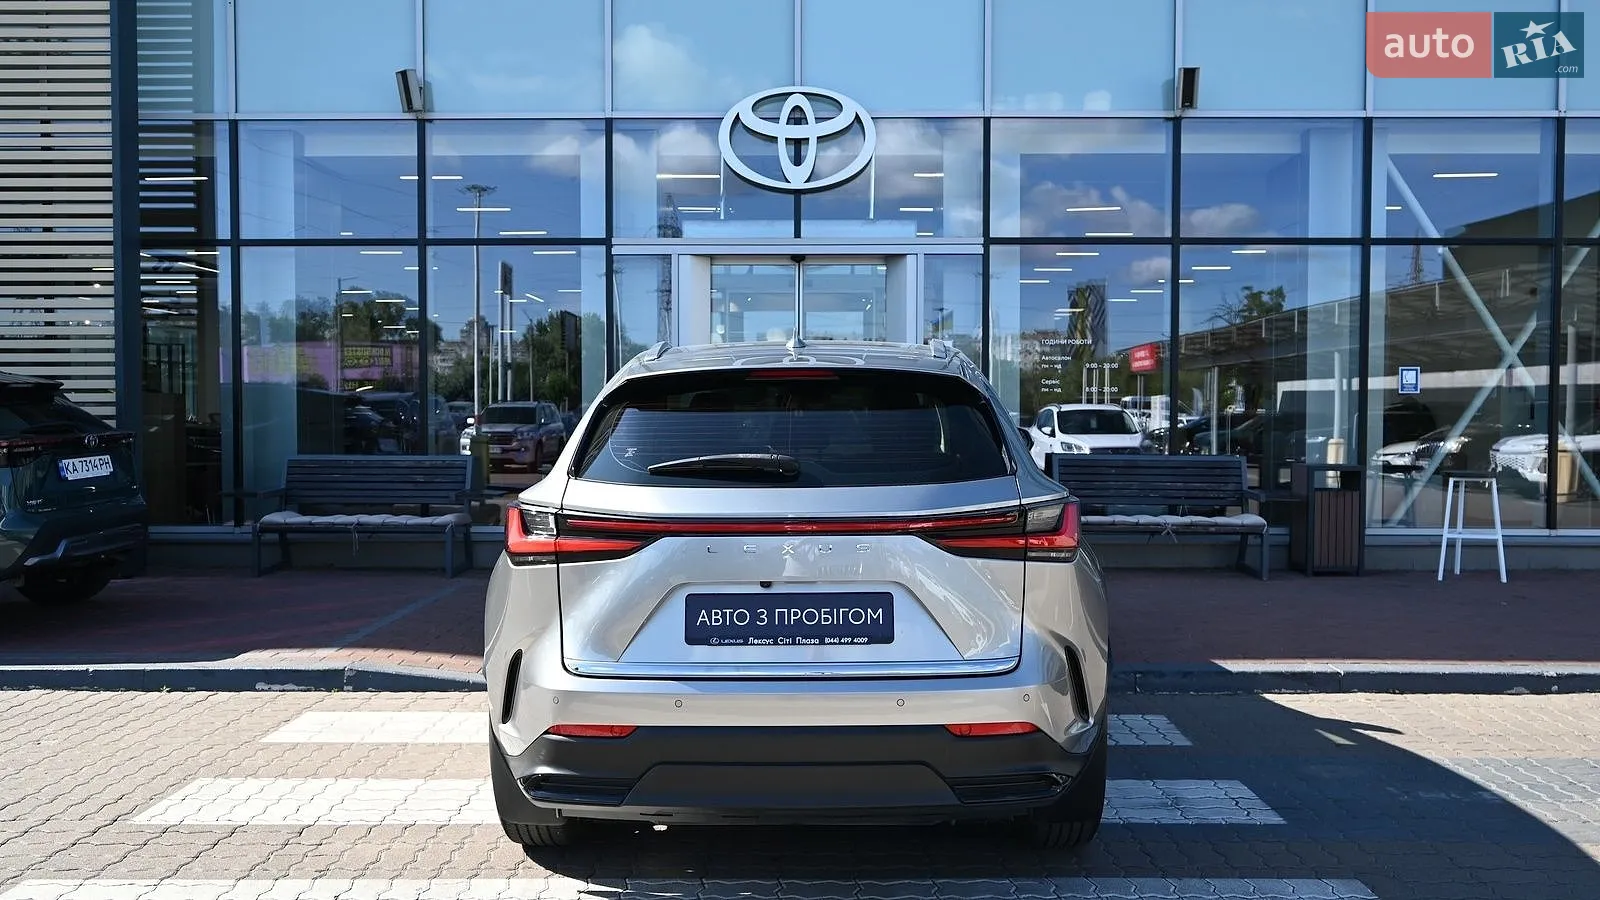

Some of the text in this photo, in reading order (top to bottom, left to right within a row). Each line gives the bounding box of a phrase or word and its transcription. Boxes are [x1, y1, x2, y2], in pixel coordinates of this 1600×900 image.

[78, 459, 99, 472] 7314
[707, 544, 871, 553] LEXUS
[696, 609, 750, 626] АВТО
[775, 608, 883, 625] ПРОБІГОМ
[747, 637, 774, 645] Лексус
[777, 636, 792, 645] Сіті
[795, 636, 820, 645] Плаза
[824, 636, 840, 644] (044)
